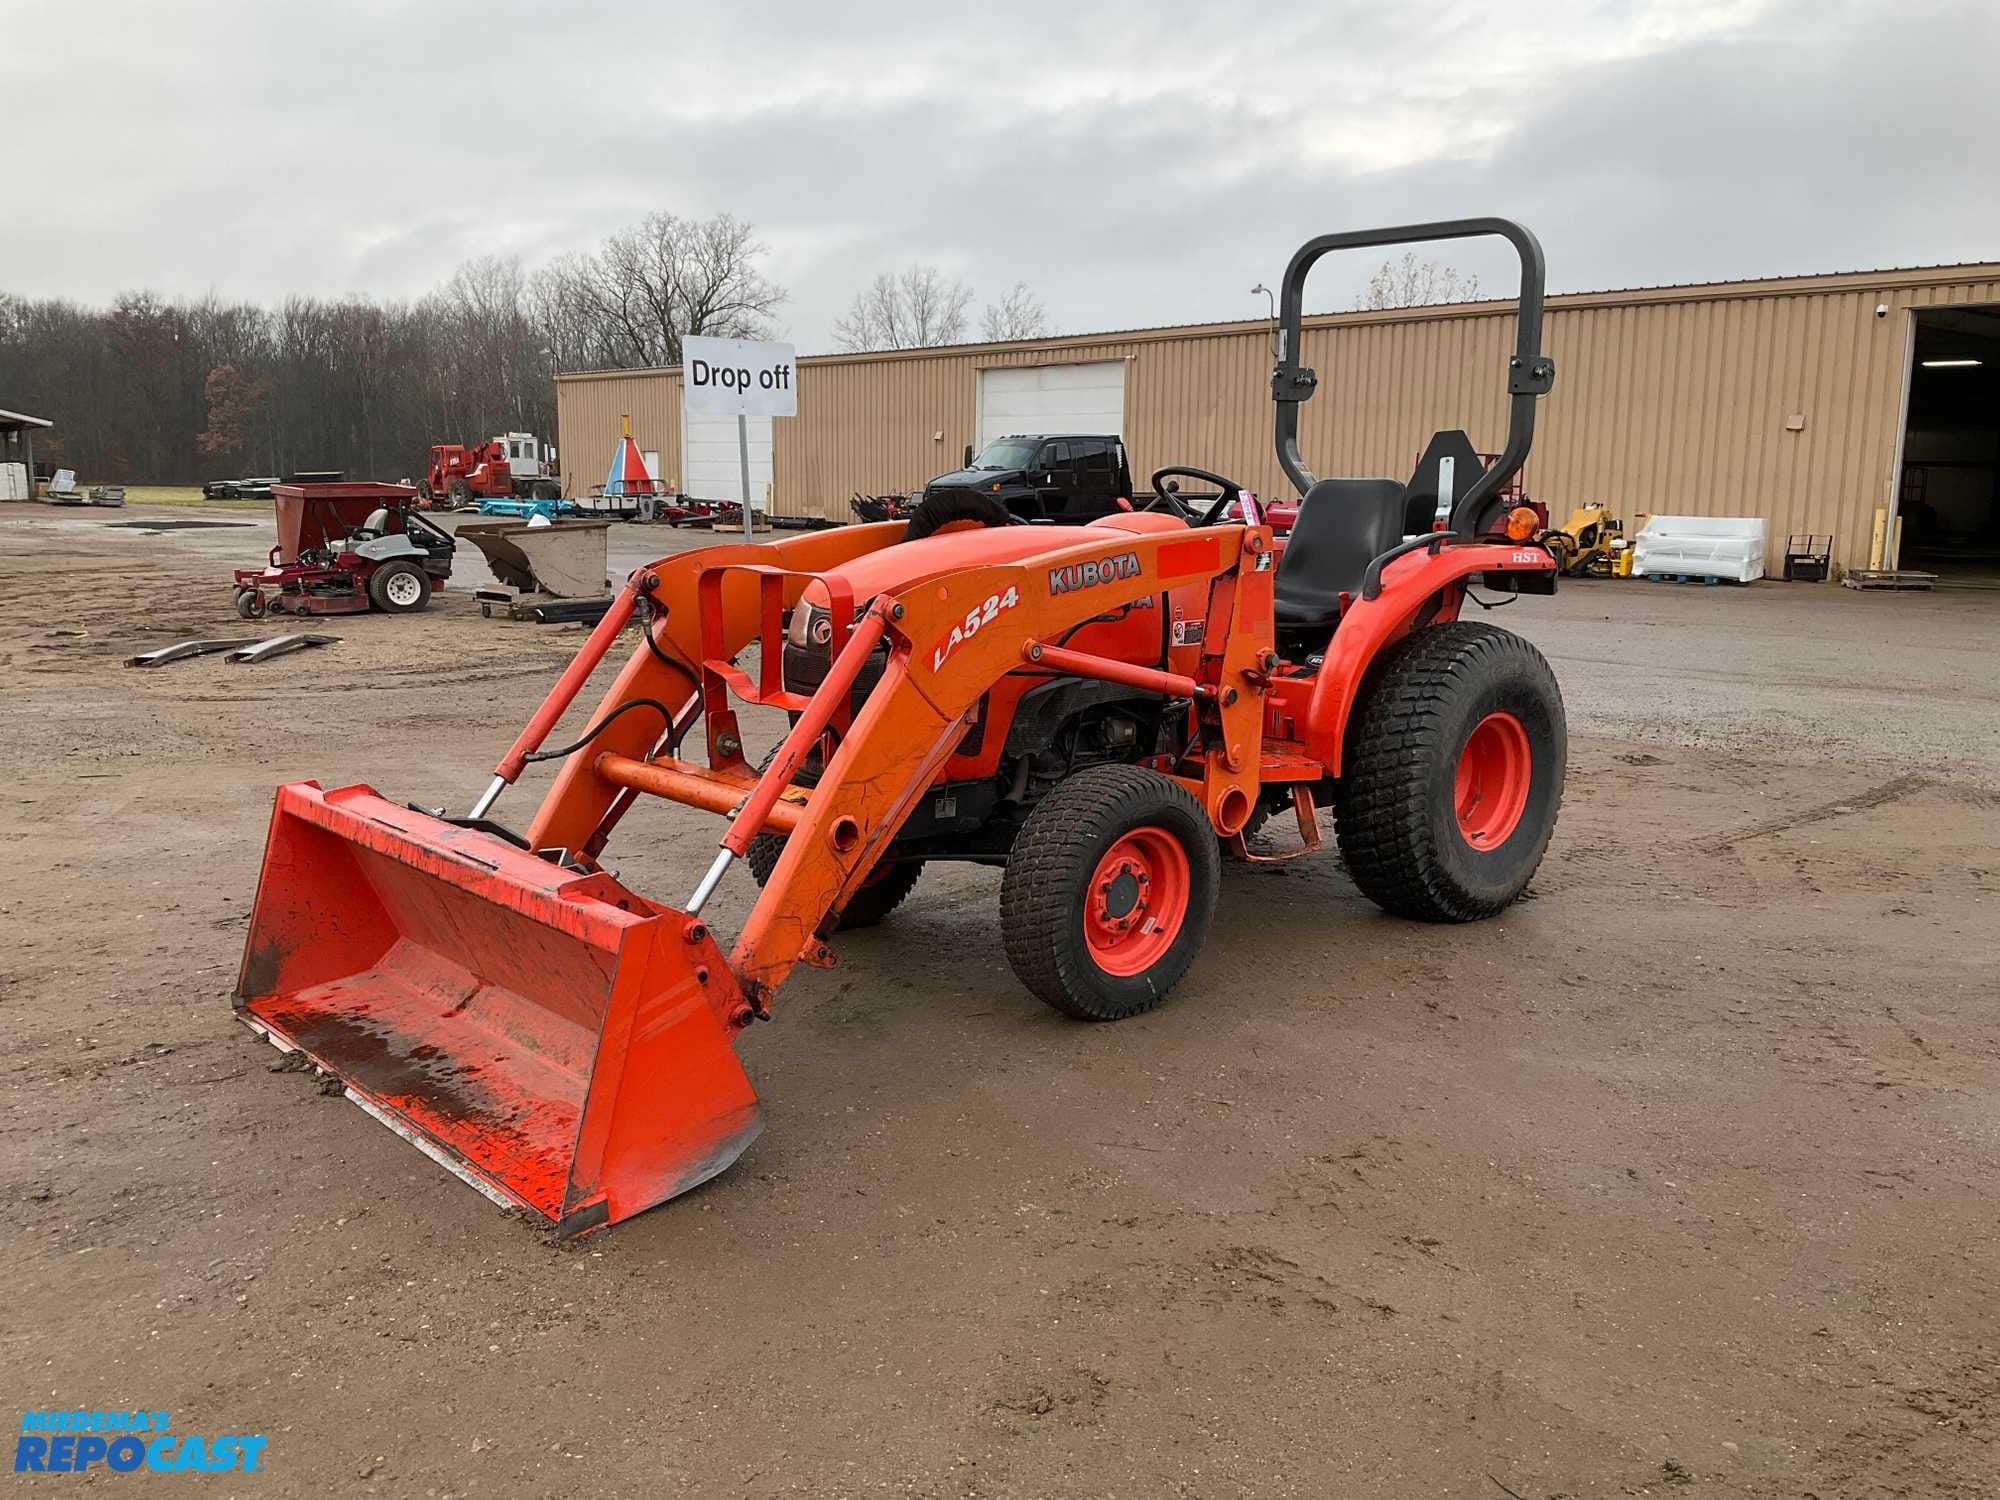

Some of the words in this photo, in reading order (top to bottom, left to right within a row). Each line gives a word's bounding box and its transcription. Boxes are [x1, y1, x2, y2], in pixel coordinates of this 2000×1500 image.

[692, 360, 751, 395] Drop
[759, 364, 790, 389] off
[1049, 552, 1142, 595] KUBOTA
[1512, 551, 1539, 563] HST
[934, 586, 1019, 673] LA524
